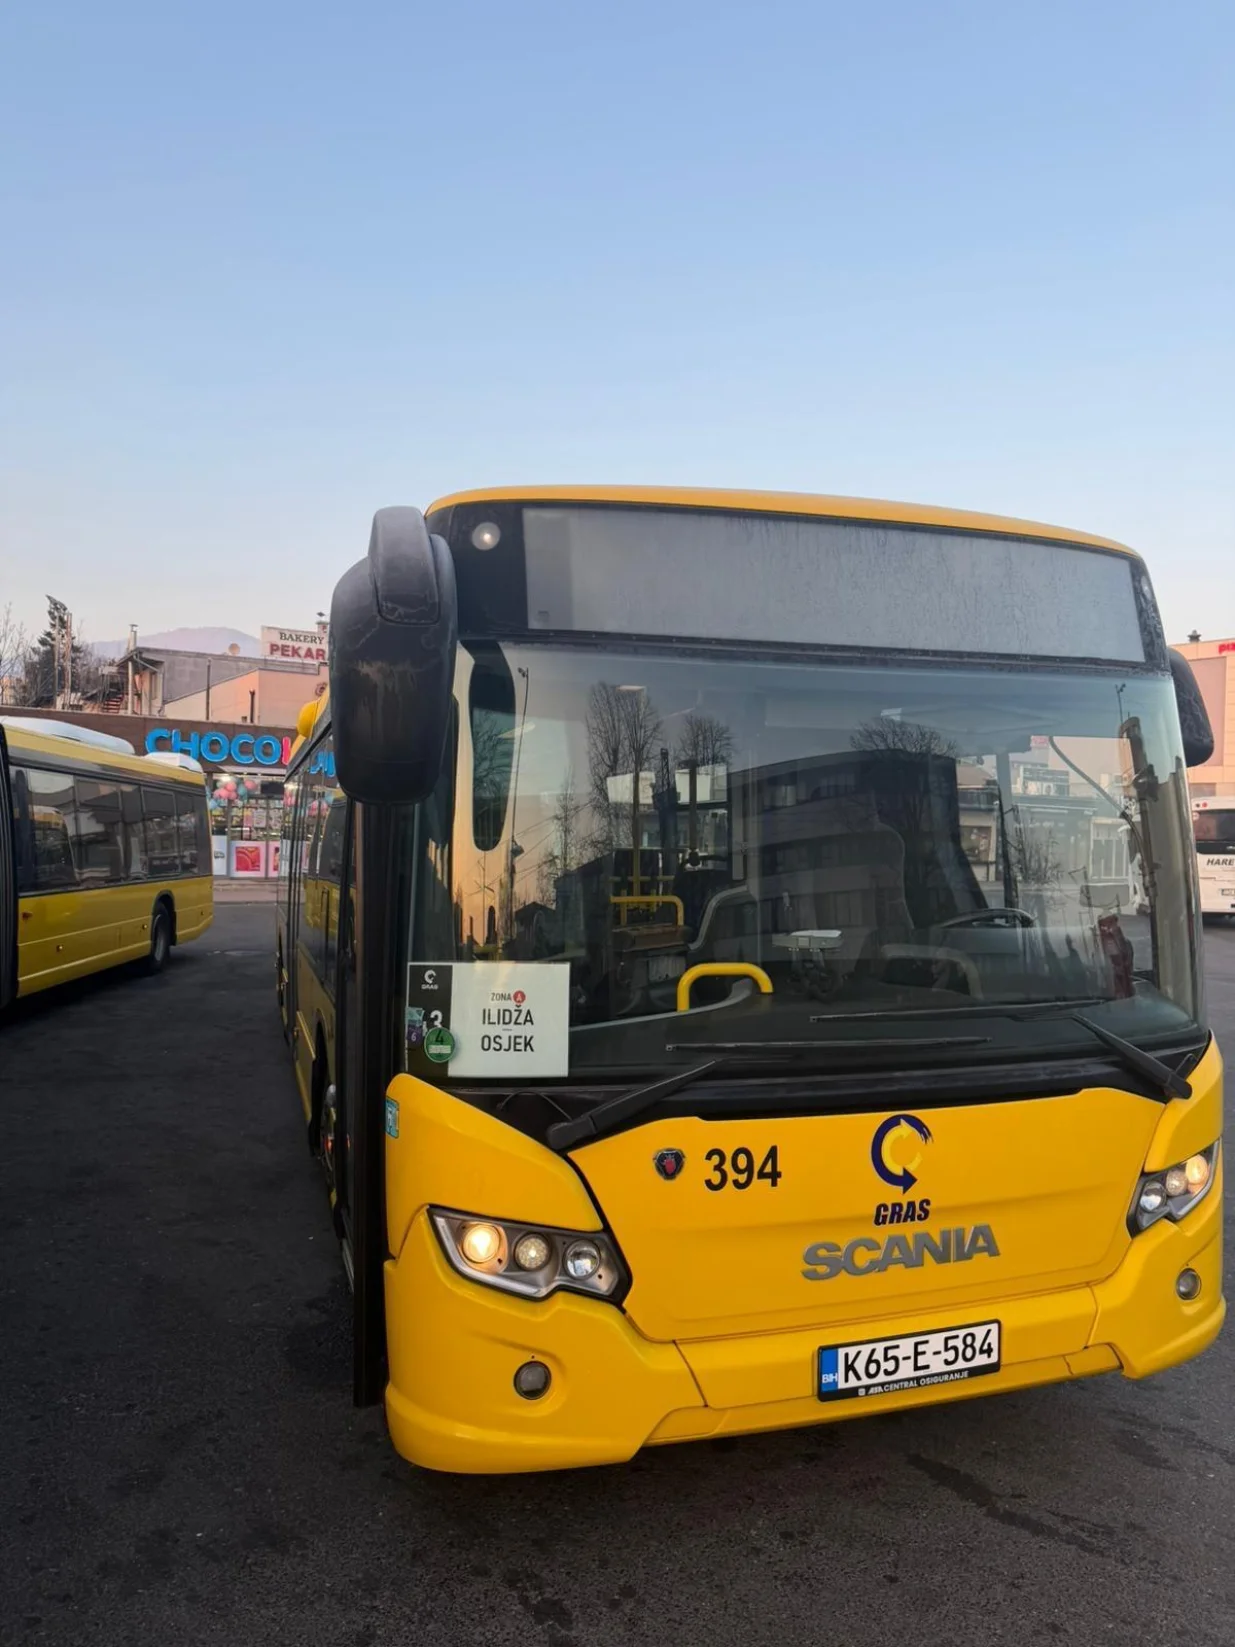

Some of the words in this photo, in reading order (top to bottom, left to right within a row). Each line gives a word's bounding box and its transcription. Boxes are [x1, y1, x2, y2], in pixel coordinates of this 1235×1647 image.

[279, 632, 325, 645] BAKERY
[490, 992, 512, 1002] ZONA
[482, 1004, 534, 1026] ILIDŽA
[435, 1029, 445, 1045] 4
[481, 1034, 534, 1052] OSJEK
[704, 1145, 782, 1191] 394
[873, 1199, 931, 1226] GRAS
[800, 1223, 1000, 1281] SCANIA
[844, 1328, 994, 1383] K65-E-584
[884, 1380, 918, 1392] CENTRAL
[920, 1371, 969, 1386] OSIGURANJE
